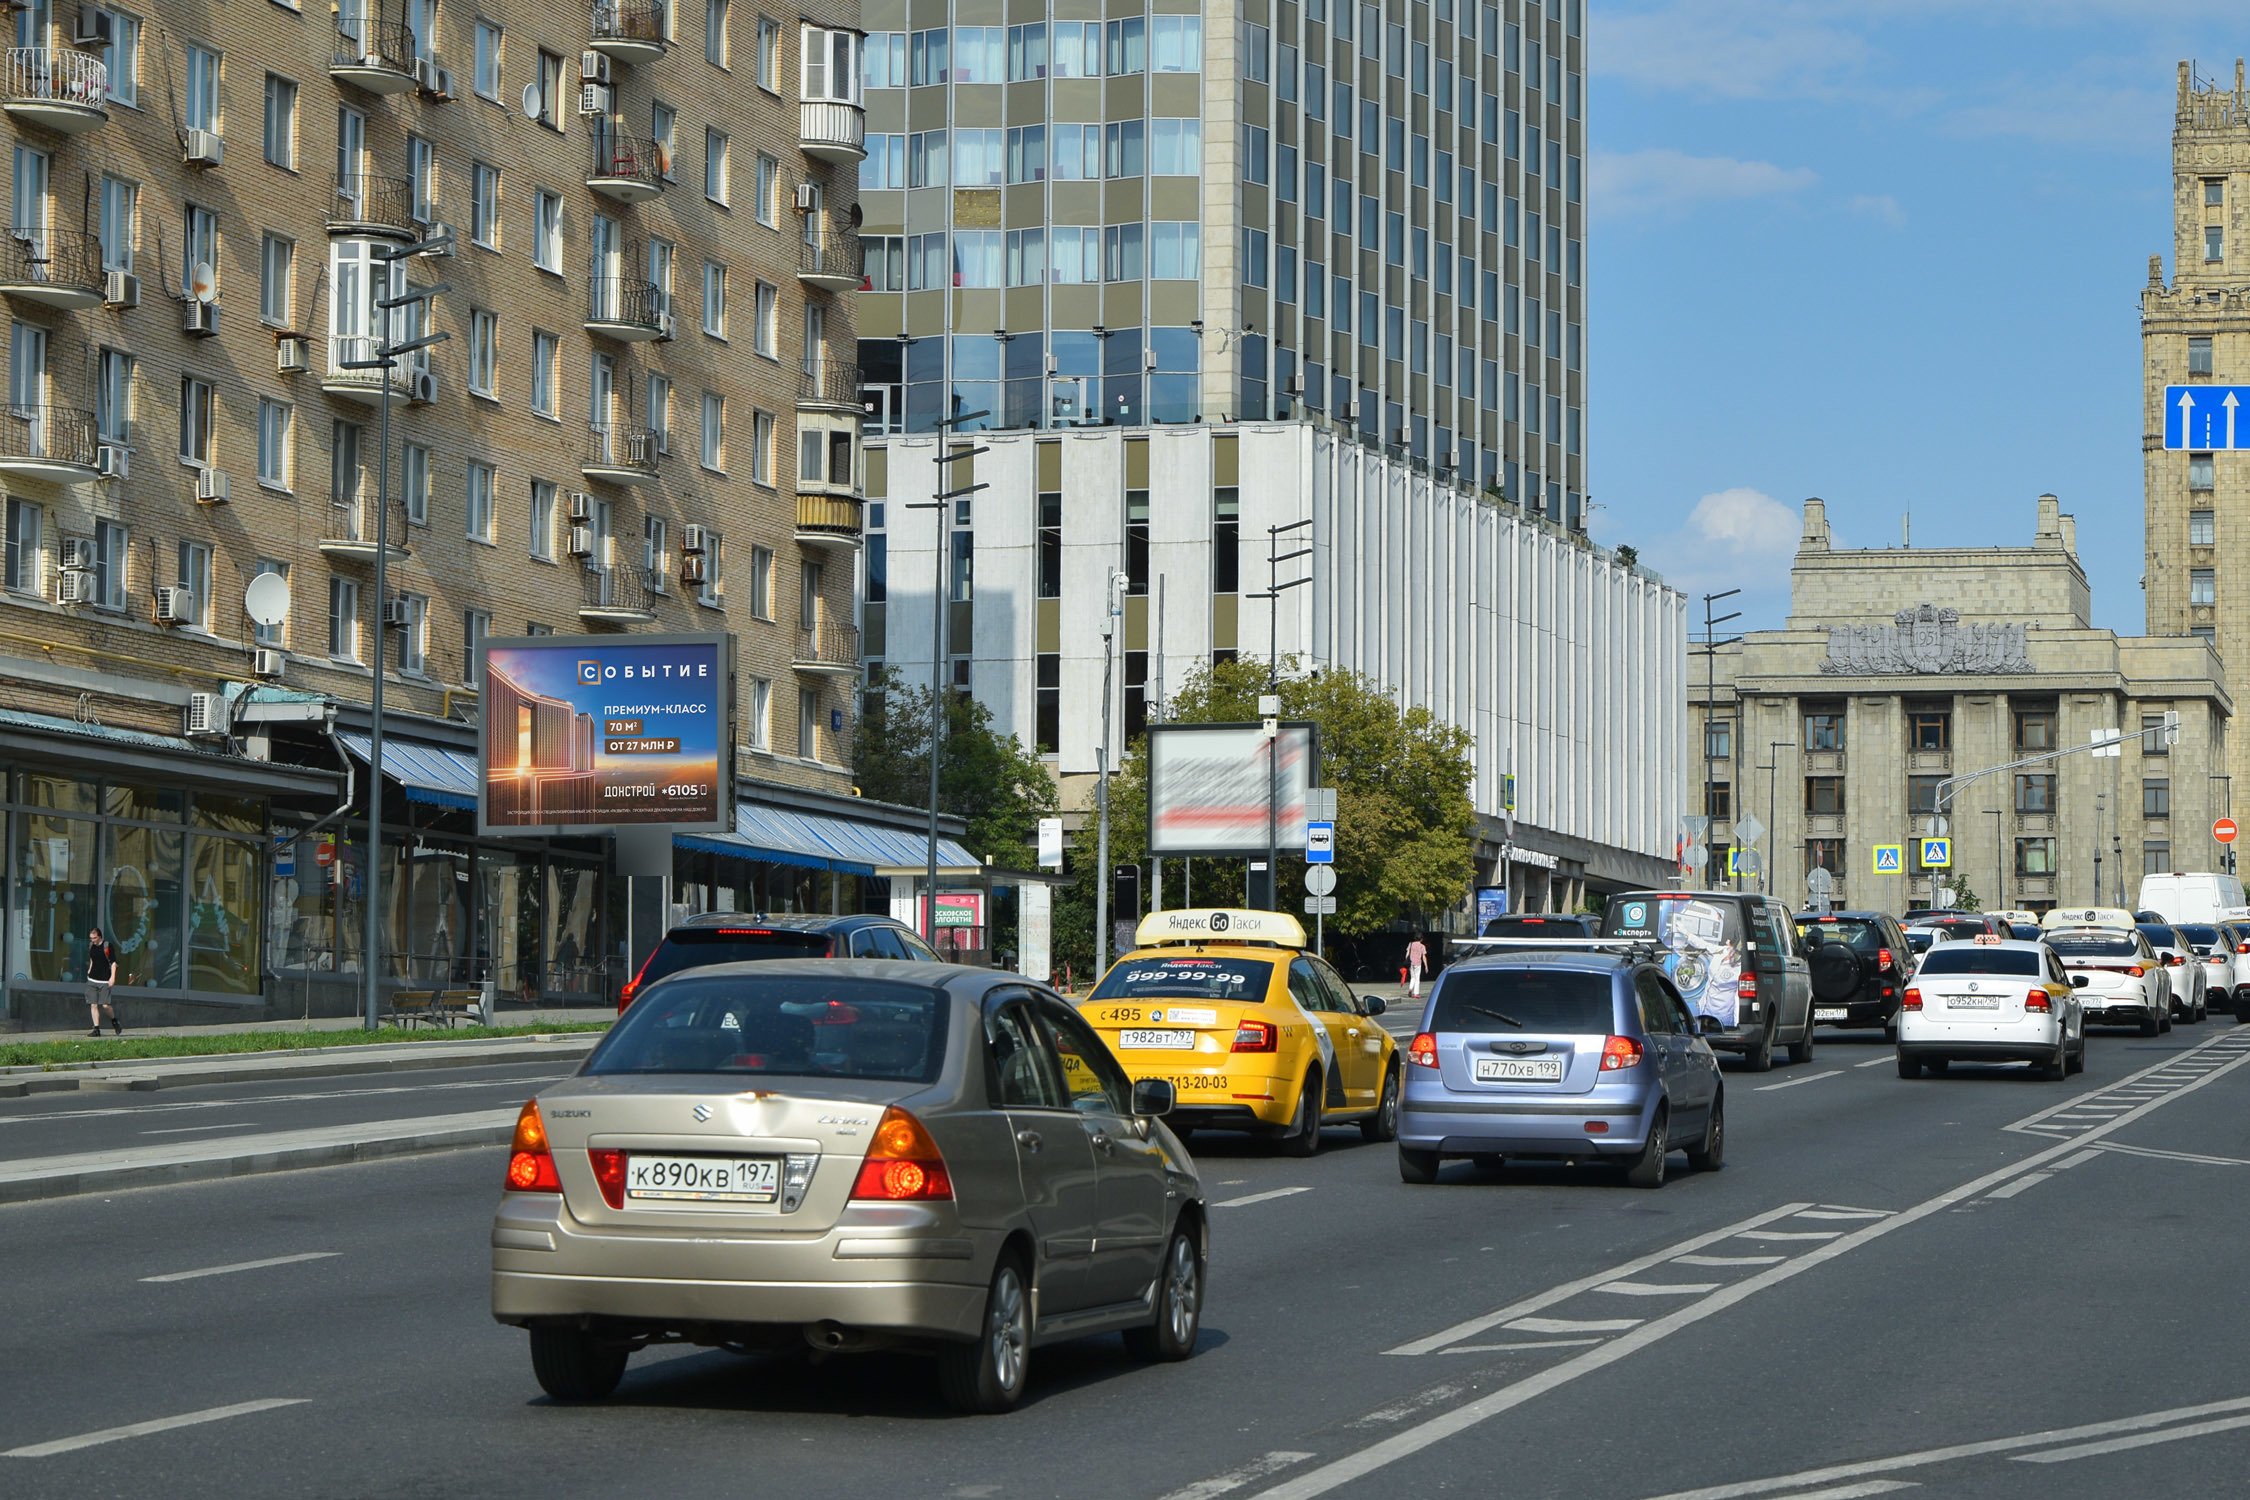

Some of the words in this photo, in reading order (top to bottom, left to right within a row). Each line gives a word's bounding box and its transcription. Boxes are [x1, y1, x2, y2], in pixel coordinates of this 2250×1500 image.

[1914, 631, 1938, 646] 1951
[584, 664, 708, 679] СОБЫТИЕ
[604, 703, 707, 716] ПРЕМИУМ-КЛАСС
[610, 722, 623, 732] 70
[609, 741, 625, 751] ОТ
[626, 741, 639, 751] 27
[640, 740, 665, 750] МЛН
[604, 782, 655, 798] ДОНСТРОЙ
[1168, 915, 1207, 930] Яндекс
[1211, 914, 1228, 930] Go
[1231, 915, 1261, 930] Такси
[2062, 911, 2083, 921] Яндекс
[2085, 911, 2095, 920] Go
[1613, 928, 1652, 938] «Эксперт»
[1126, 971, 1246, 984] 999-99-99
[1109, 1008, 1141, 1021] 495
[1173, 1031, 1191, 1040] 797
[1538, 1063, 1557, 1073] 199
[551, 1110, 591, 1118] SUZUKI
[736, 1163, 771, 1181] 197
[743, 1182, 760, 1190] RUS
